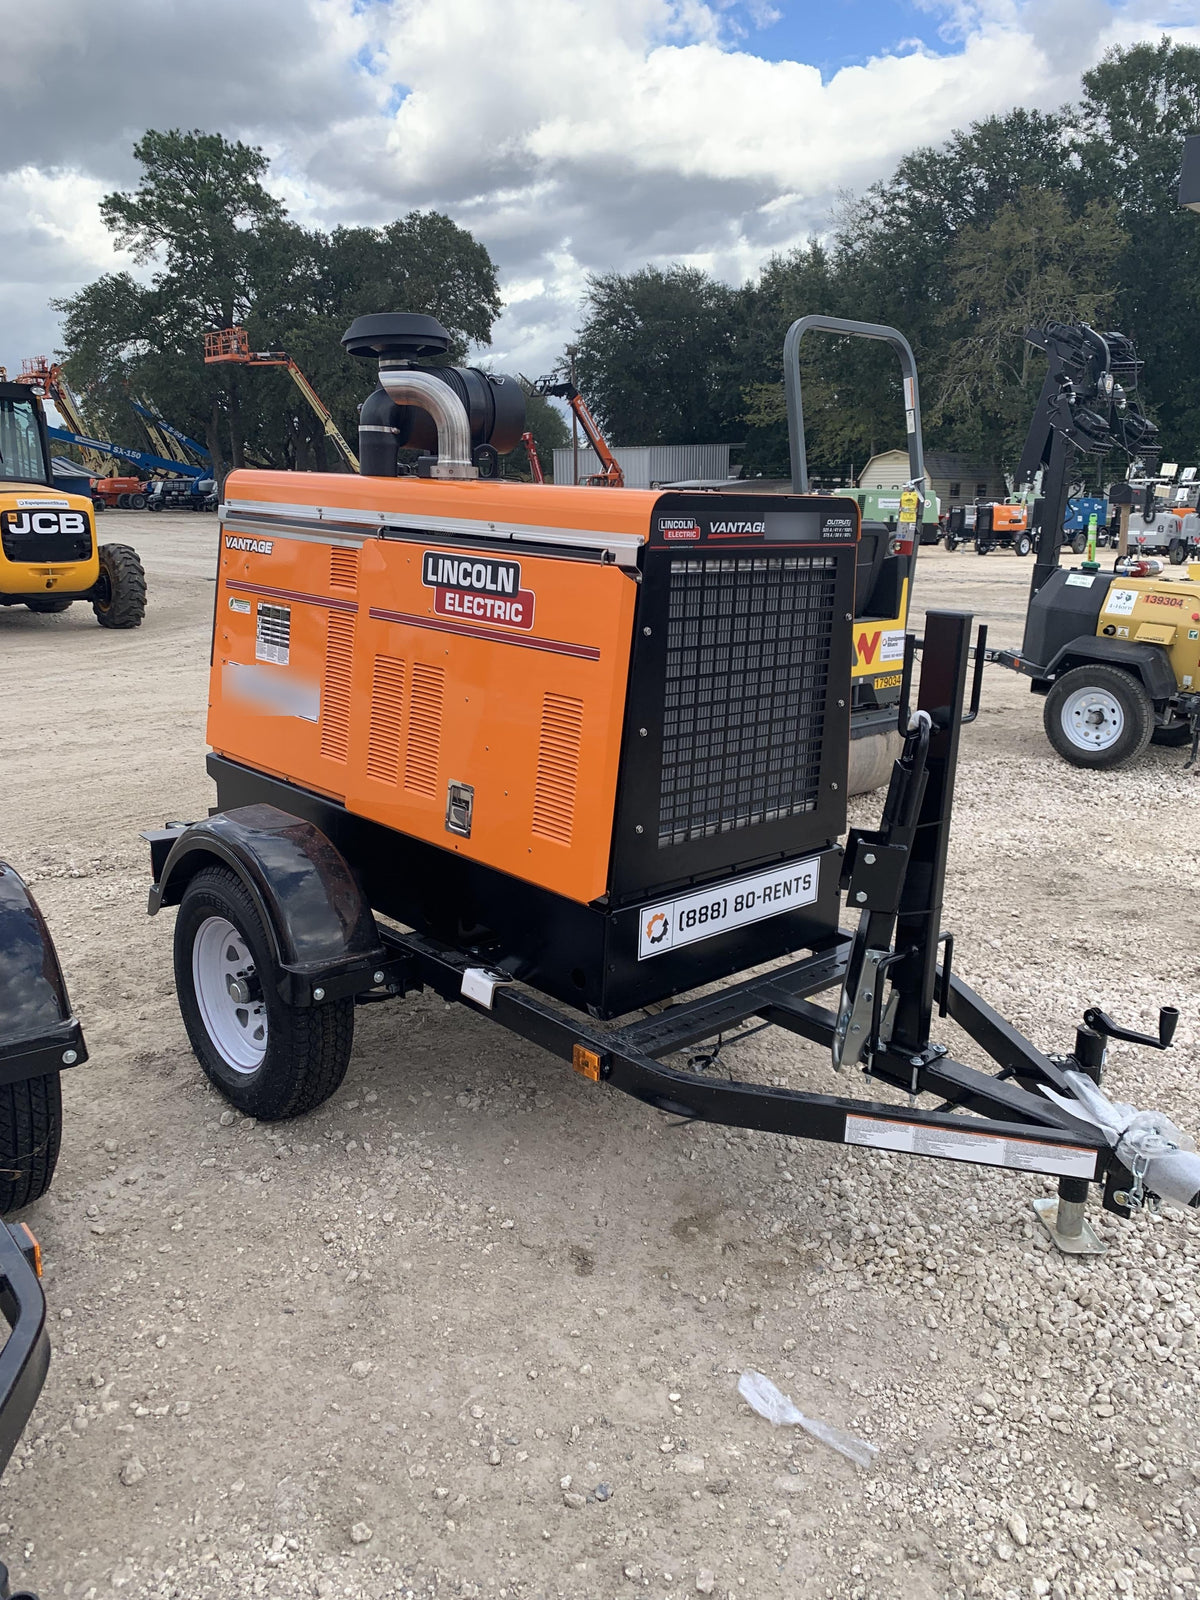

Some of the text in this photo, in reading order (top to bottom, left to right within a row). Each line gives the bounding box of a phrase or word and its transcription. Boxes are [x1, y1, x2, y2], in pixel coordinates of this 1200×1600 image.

[112, 445, 142, 460] SX-150
[8, 513, 85, 534] JCB
[660, 520, 695, 530] LINCOLN
[667, 531, 697, 539] ELECTRIC
[224, 534, 273, 556] VANTAGE
[426, 557, 515, 594] LINCOLN
[444, 592, 524, 623] ELECTRIC
[1144, 594, 1185, 608] 139304
[874, 674, 902, 689] 179034
[678, 873, 813, 932] (888) 80-RENTS
